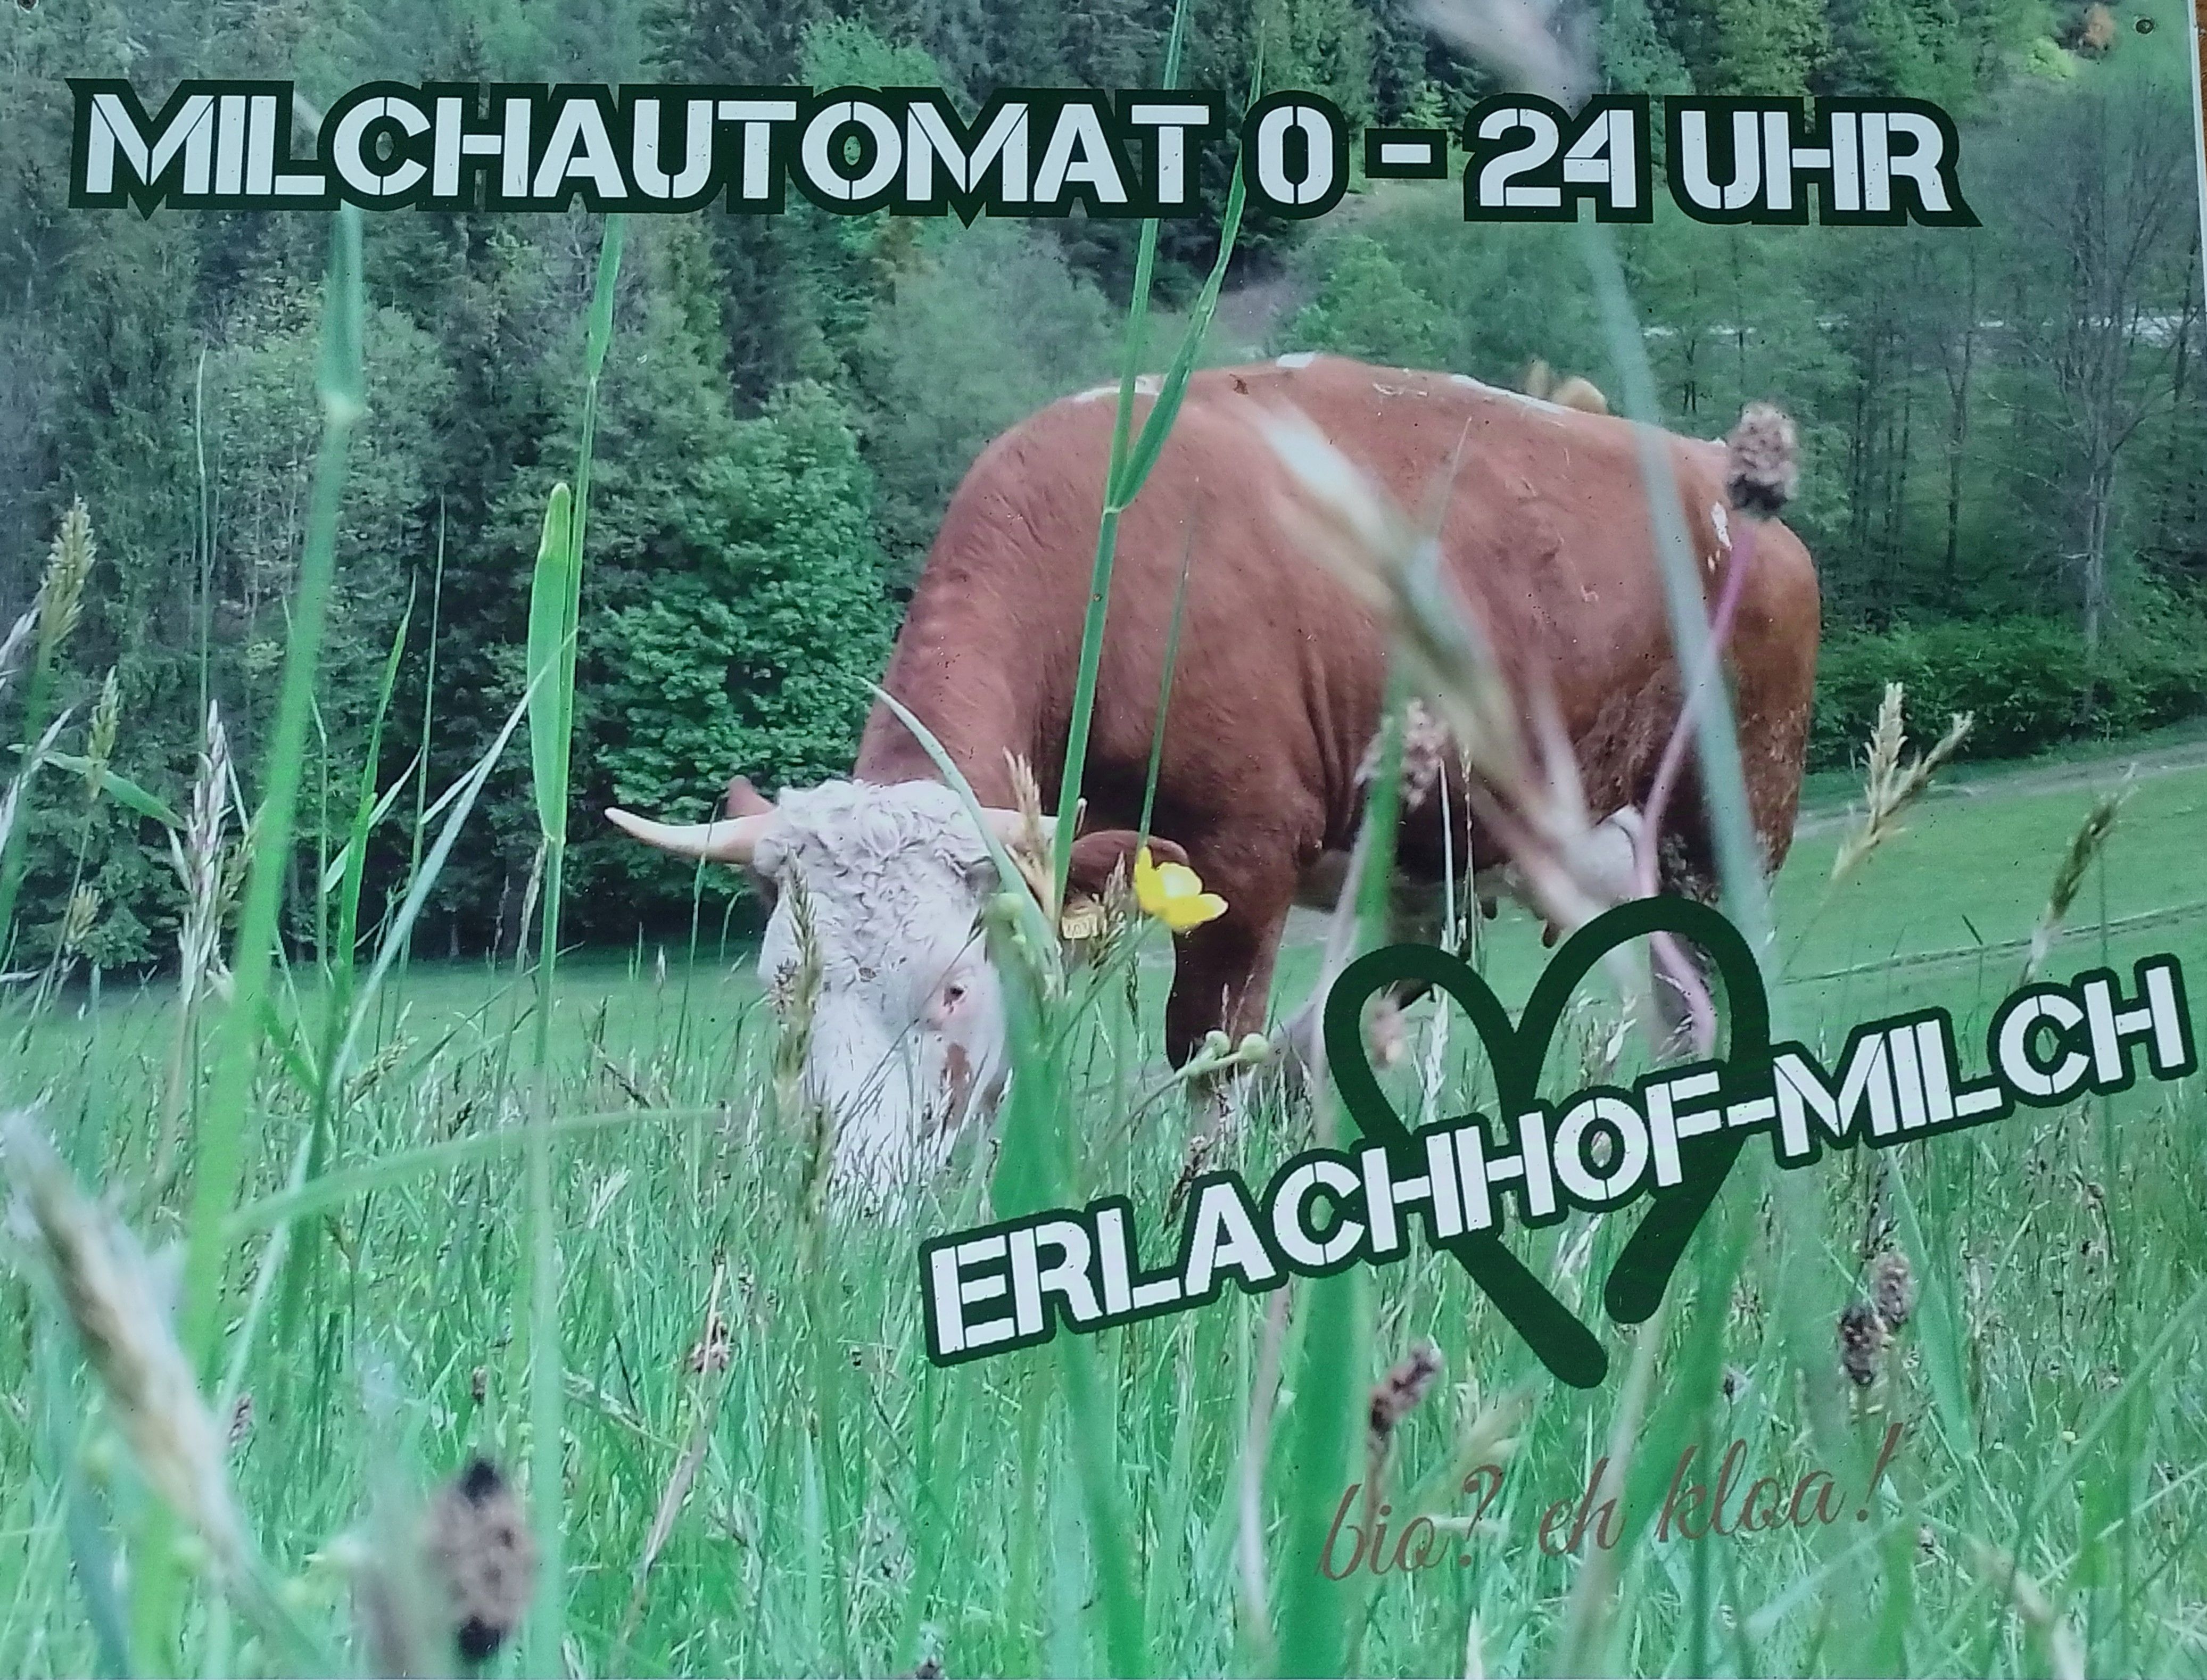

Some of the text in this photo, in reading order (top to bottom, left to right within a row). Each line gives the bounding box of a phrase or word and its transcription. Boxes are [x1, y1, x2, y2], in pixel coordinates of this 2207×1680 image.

[84, 93, 1211, 204] MILCHAUTOMAT
[1256, 103, 1335, 206] 0
[1477, 106, 1639, 210] 24
[1679, 108, 1954, 213] UHR
[931, 963, 2187, 1355] ERLACHHOF-MILCH
[1316, 1422, 1904, 1580] bio? eh kloa!
